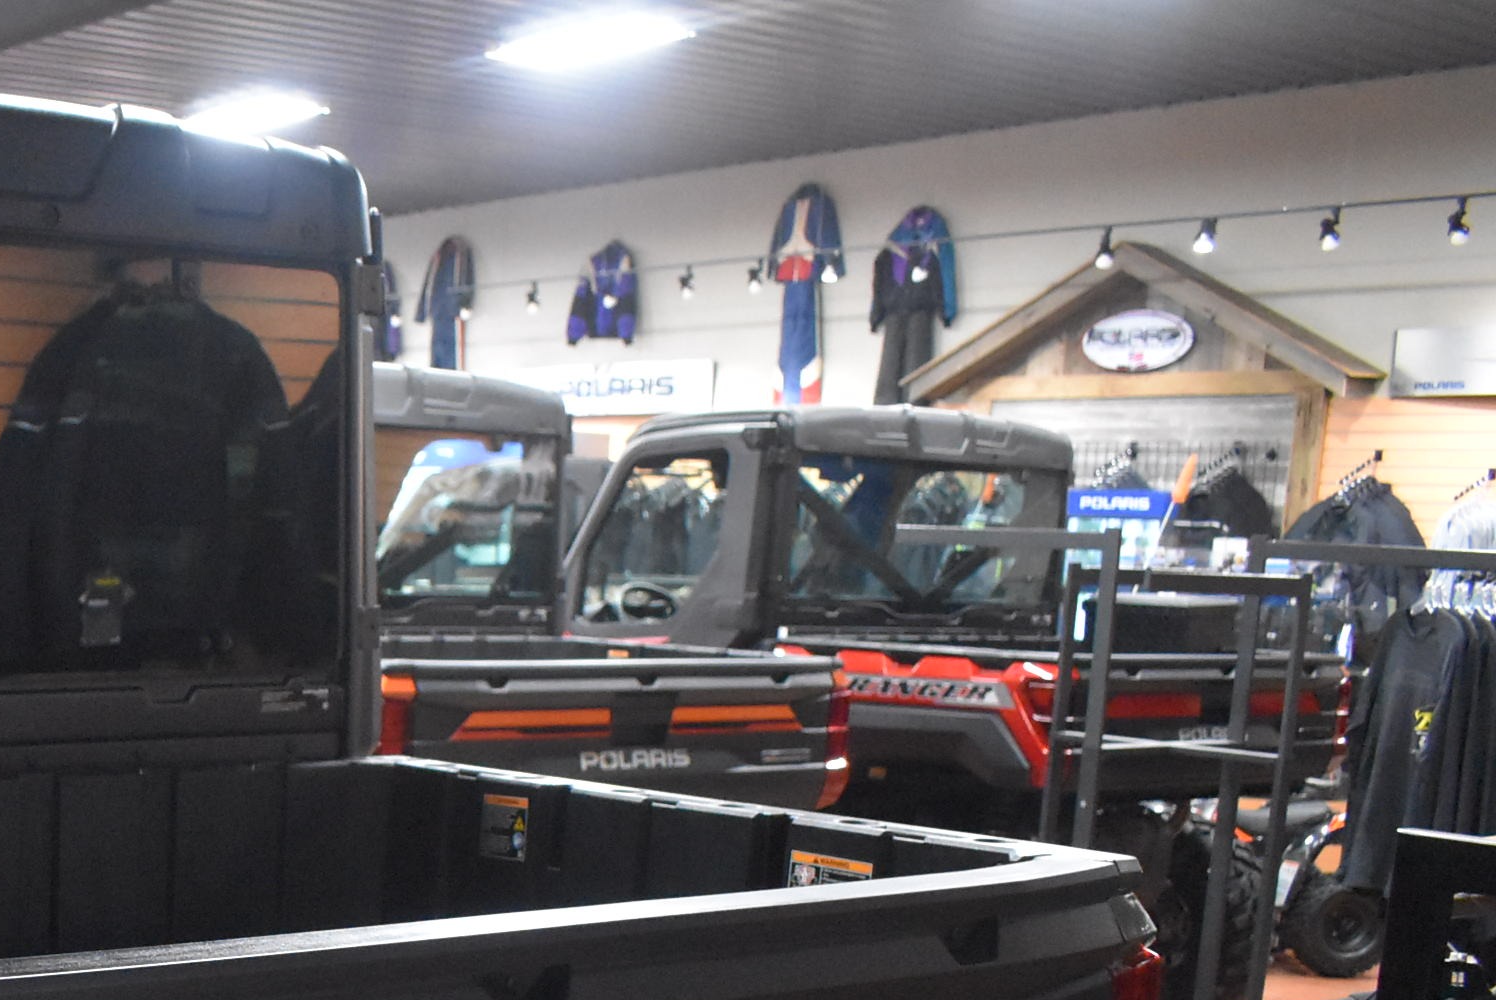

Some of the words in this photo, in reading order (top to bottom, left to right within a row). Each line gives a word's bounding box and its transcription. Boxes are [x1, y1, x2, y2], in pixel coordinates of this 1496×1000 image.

[1079, 495, 1150, 511] POLARIS
[847, 676, 993, 700] RANGER
[580, 748, 691, 772] POLARIS
